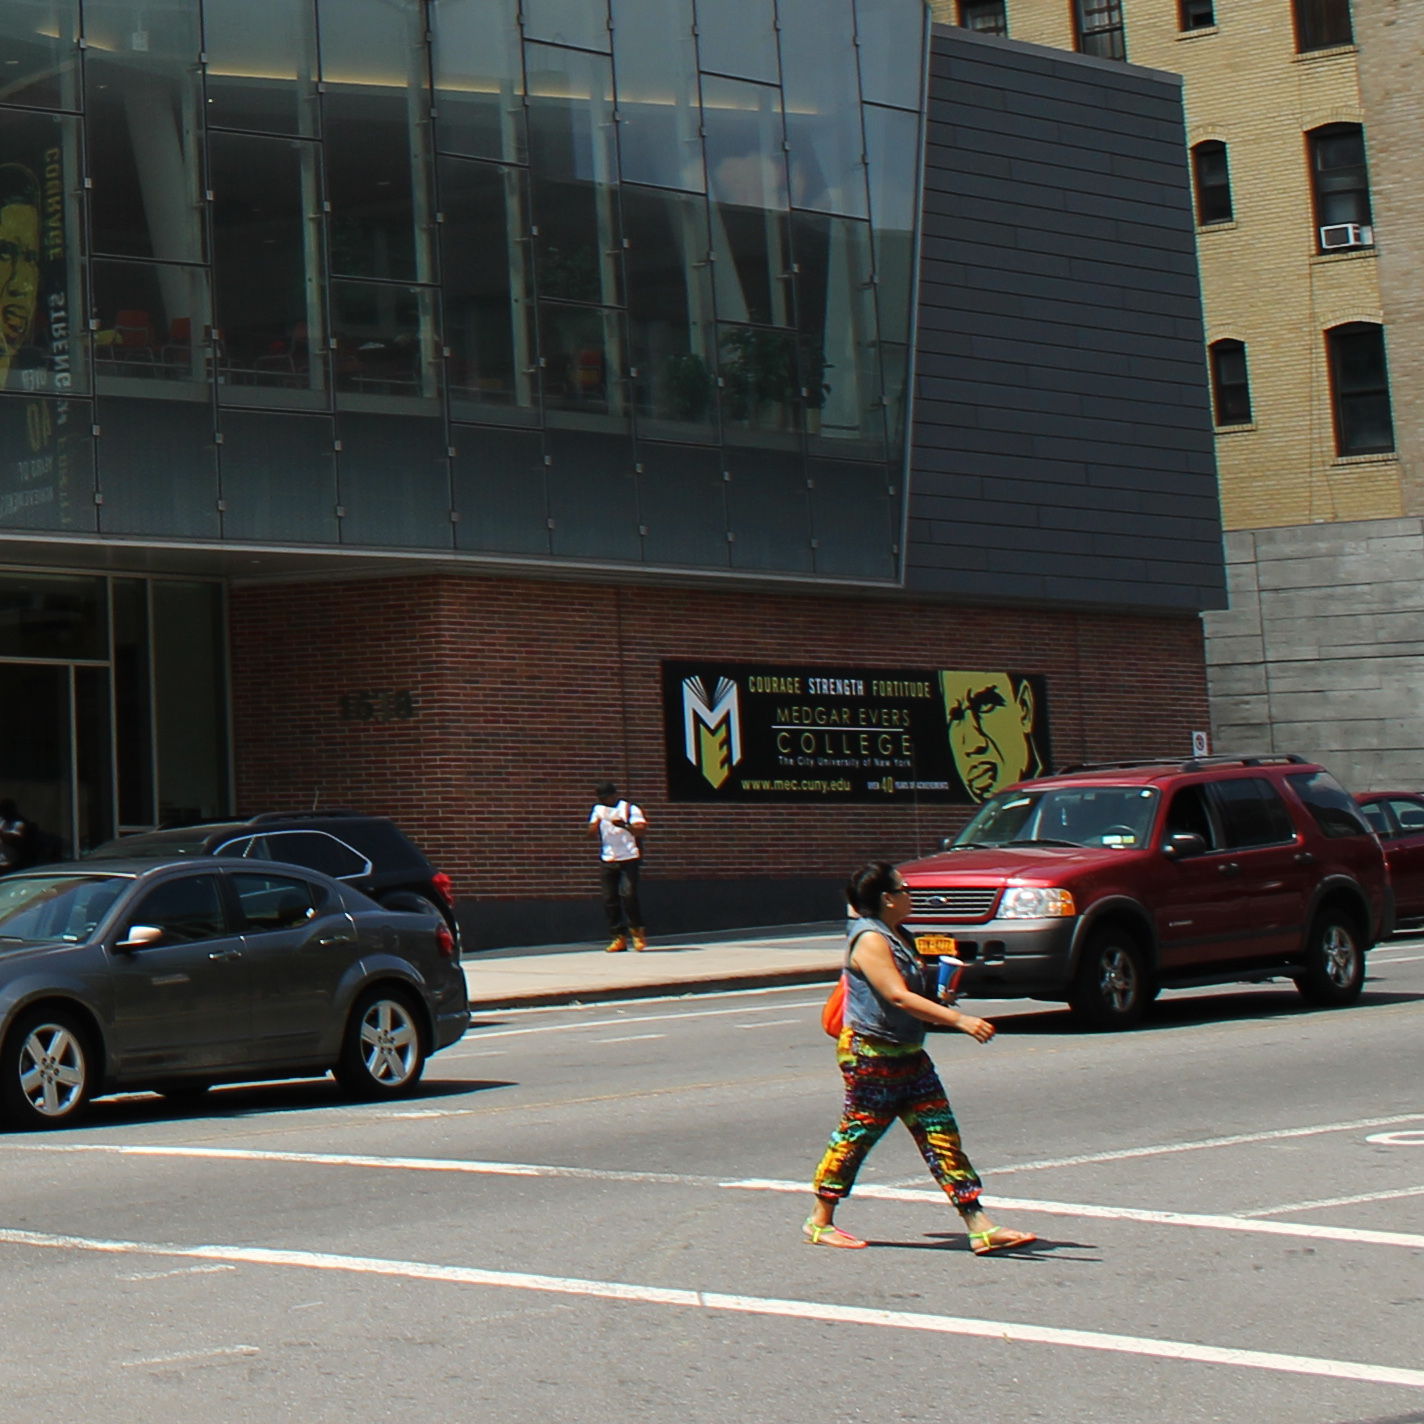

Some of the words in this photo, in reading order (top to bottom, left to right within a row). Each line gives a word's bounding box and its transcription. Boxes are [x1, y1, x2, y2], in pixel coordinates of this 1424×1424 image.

[748, 676, 802, 694] COURAGE
[808, 678, 865, 696] STRENGTH
[872, 680, 932, 698] FORTITUDE
[776, 706, 851, 724] MEDGAR
[859, 708, 910, 726] EVERS
[776, 732, 912, 755] COLLEGE
[778, 756, 794, 766] The
[797, 756, 814, 768] City
[818, 756, 860, 768] University
[863, 758, 872, 767] of
[874, 758, 891, 767] New
[894, 759, 912, 767] York
[741, 778, 852, 794] www.mec.cuny.edu
